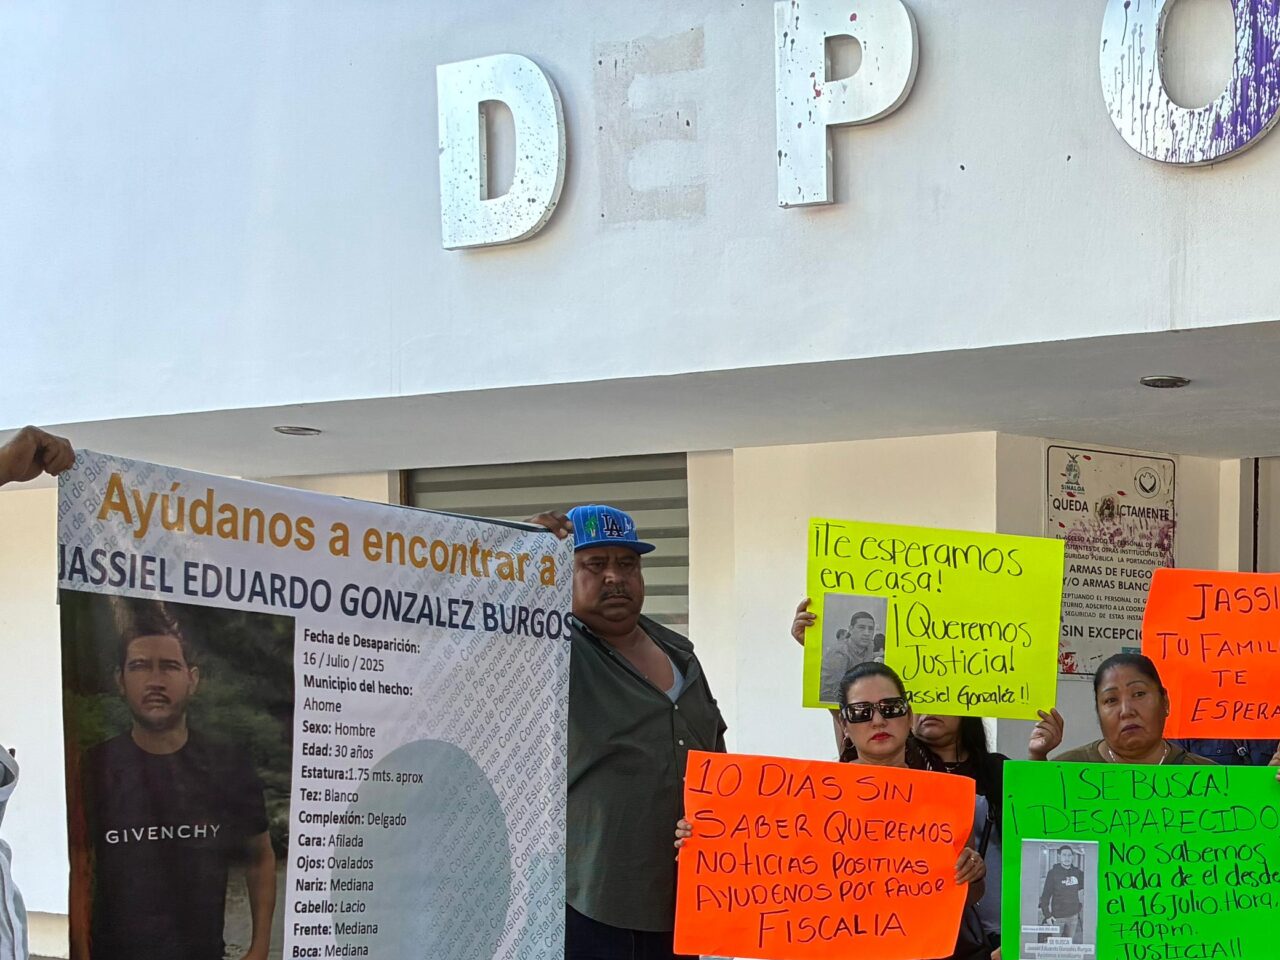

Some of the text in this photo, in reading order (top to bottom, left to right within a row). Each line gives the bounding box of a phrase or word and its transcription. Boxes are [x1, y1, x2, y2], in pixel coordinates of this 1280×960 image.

[1052, 498, 1089, 512] QUEDA
[97, 472, 555, 586] Ayúdanos a encontrar a
[860, 536, 1023, 577] esperamos
[820, 567, 943, 594] en casa!
[1069, 564, 1152, 579] ARMAS DE FUEGO
[58, 544, 573, 641] JASSIEL EDUARDO GONZALEZ BURGOS
[1082, 578, 1115, 589] ARMAS
[1062, 625, 1083, 637] SIN
[304, 629, 421, 654] Fecha de Desaparición:
[1156, 632, 1189, 660] TU
[303, 652, 316, 665] 16
[326, 654, 350, 669] Julio
[360, 658, 384, 672] 2025
[304, 675, 413, 696] Municipio del hecho:
[1211, 669, 1248, 688] TE
[689, 758, 914, 803] 10 DIAS SIN
[298, 810, 407, 829] Complexión: Delgado
[693, 809, 953, 845] SABER QUEREMOS
[105, 825, 220, 844] GIVENCHY
[298, 834, 364, 848] Cara: Afilada
[297, 856, 374, 871] Ojos: Ovalados
[295, 878, 374, 892] Nariz: Mediana
[1105, 861, 1280, 891] nada de el desde
[294, 900, 366, 914] Cabello: Lacio
[696, 883, 832, 913] AYUDENOS
[1106, 890, 1125, 916] el
[1132, 890, 1167, 918] 16
[293, 922, 378, 936] Frente: Mediana
[759, 909, 907, 948] FISCALIA
[292, 944, 369, 958] Boca: Mediana
